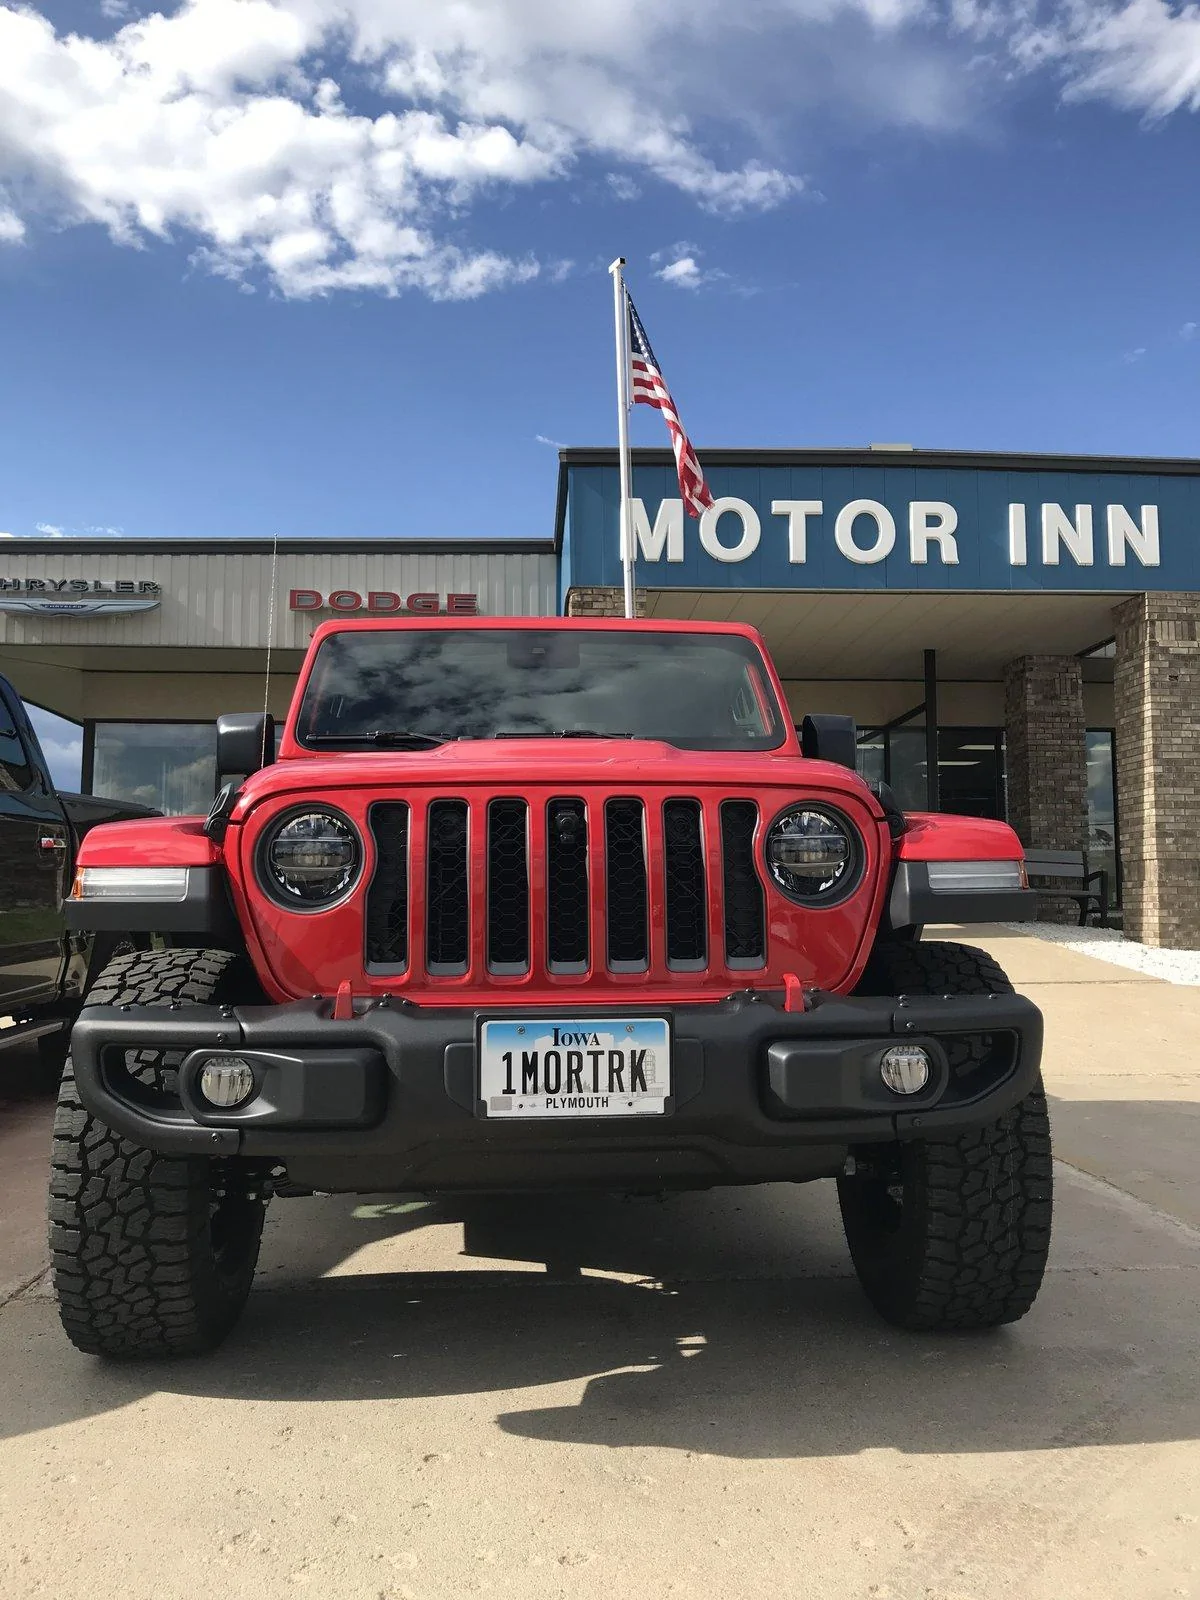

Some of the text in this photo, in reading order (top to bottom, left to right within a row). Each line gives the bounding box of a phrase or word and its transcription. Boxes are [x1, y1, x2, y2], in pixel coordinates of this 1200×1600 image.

[620, 497, 1161, 567] MOTOR INN
[290, 589, 477, 615] DODGE
[502, 1049, 648, 1095] 1MORTRK
[545, 1096, 609, 1109] PLYMOUTH
